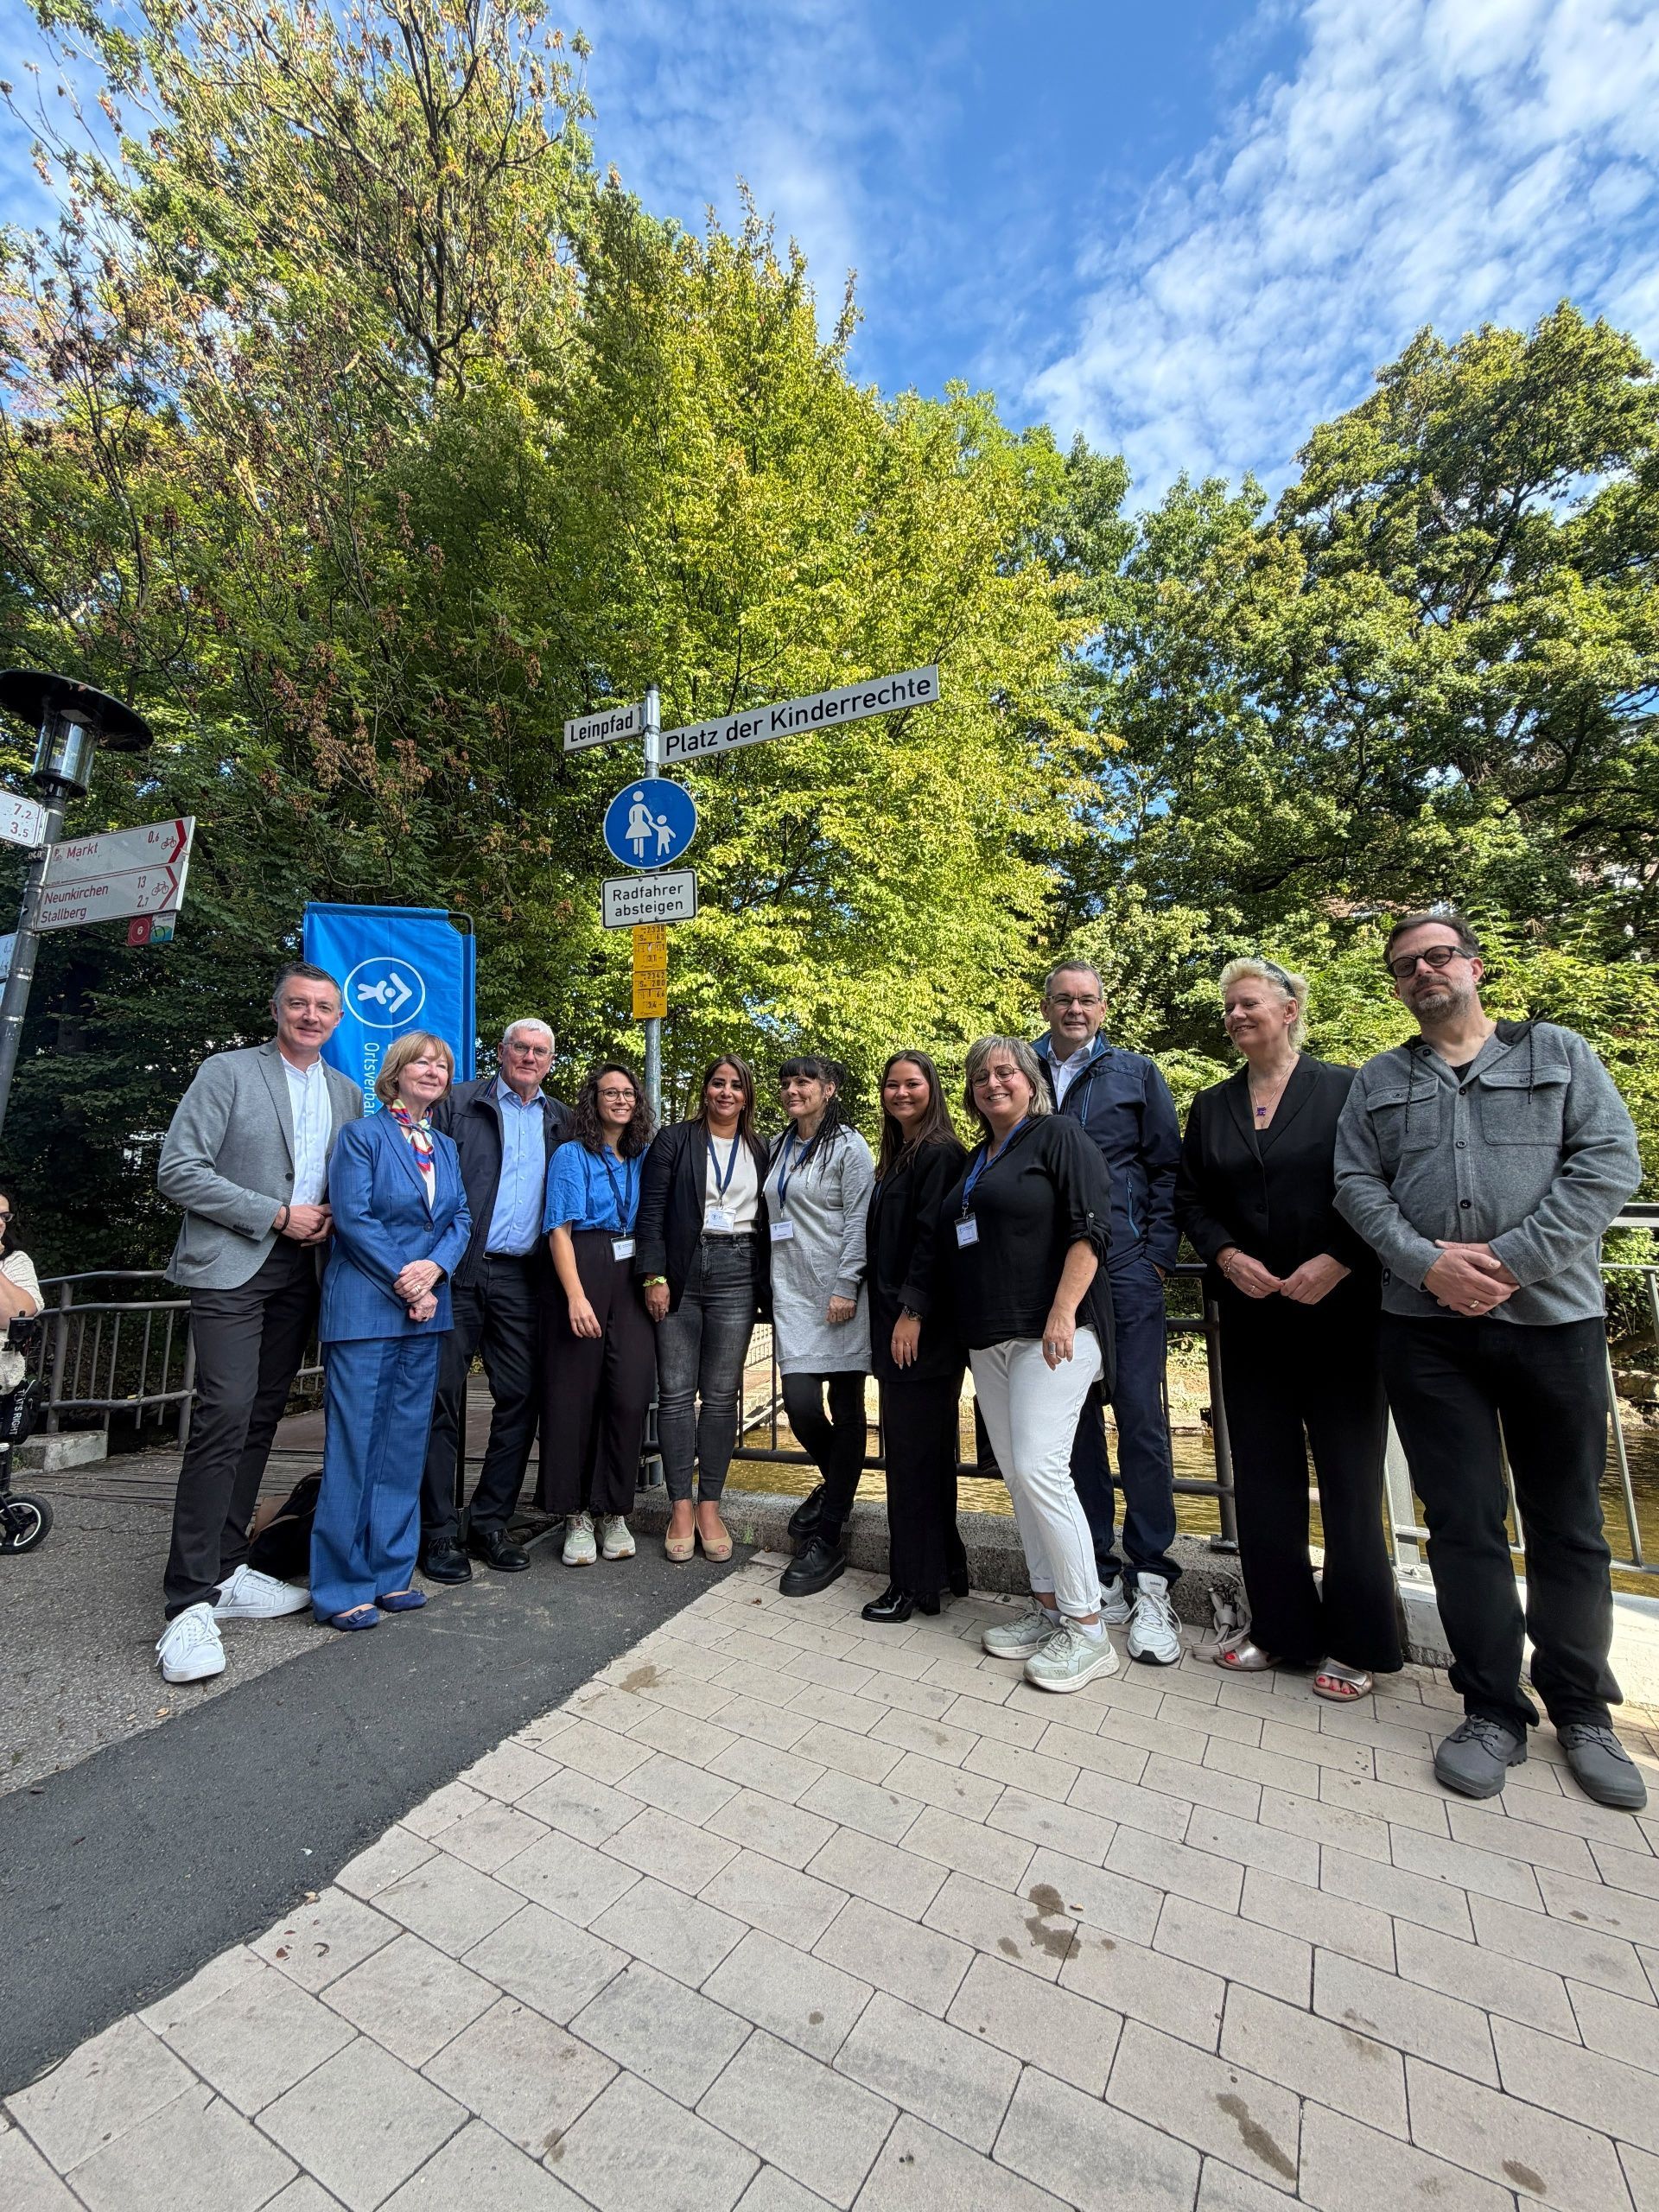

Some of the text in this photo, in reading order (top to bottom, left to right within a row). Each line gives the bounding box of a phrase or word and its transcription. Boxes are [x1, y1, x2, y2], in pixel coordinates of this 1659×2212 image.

[570, 710, 633, 742] Leinpfad
[666, 678, 931, 756] Platz der Kinderrechte
[67, 842, 99, 859] Markt
[148, 830, 160, 843] 0,6
[44, 875, 147, 905] Neunkirchen 13
[613, 884, 683, 901] Radfahrer
[41, 894, 149, 924] Stallberg 2,7
[615, 900, 683, 917] absteigen
[137, 926, 143, 936] 6
[364, 1042, 380, 1117] Ortsverban
[10, 1412, 22, 1434] RIGHT
